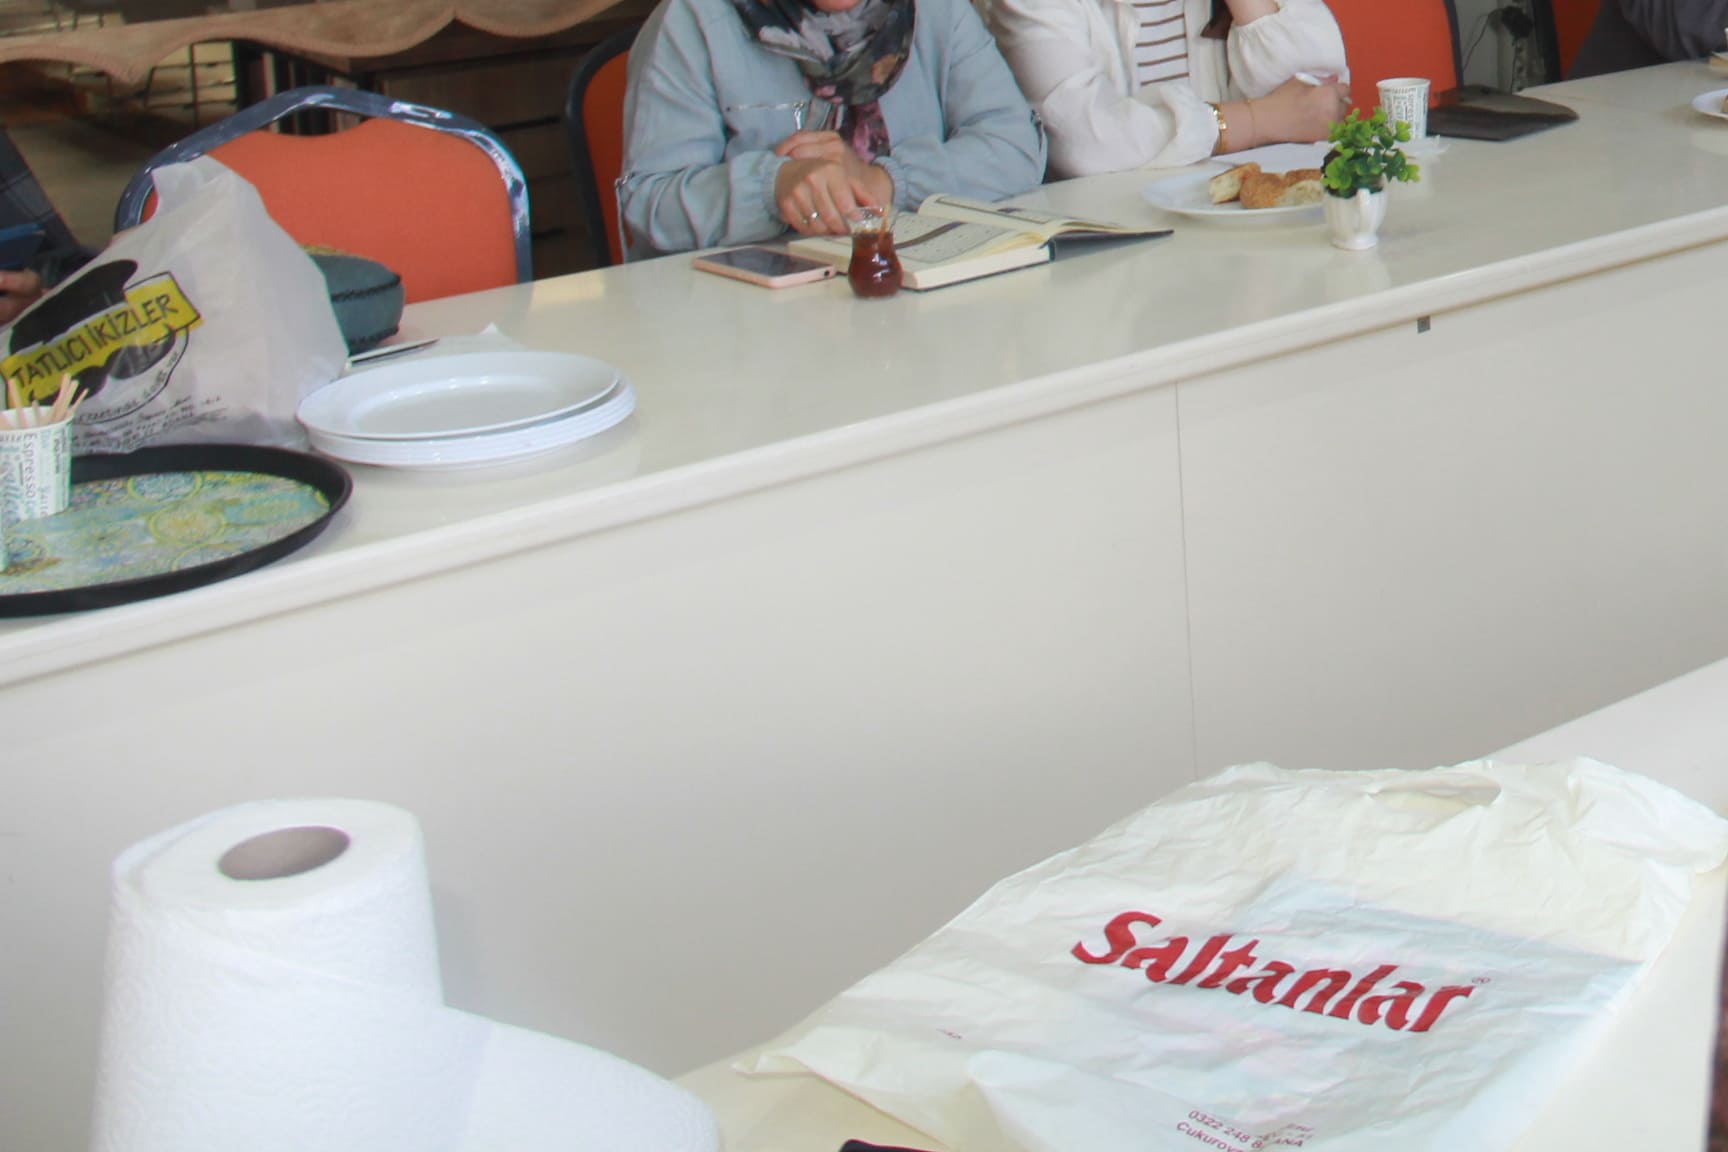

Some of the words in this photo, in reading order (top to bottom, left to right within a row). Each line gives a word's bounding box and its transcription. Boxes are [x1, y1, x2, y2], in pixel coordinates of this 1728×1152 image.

[11, 331, 92, 389] TATLICI
[88, 294, 179, 348] İKİZLER
[1071, 910, 1474, 1032] Saltanlar
[1187, 1109, 1224, 1131] 0322
[1223, 1125, 1251, 1144] 248
